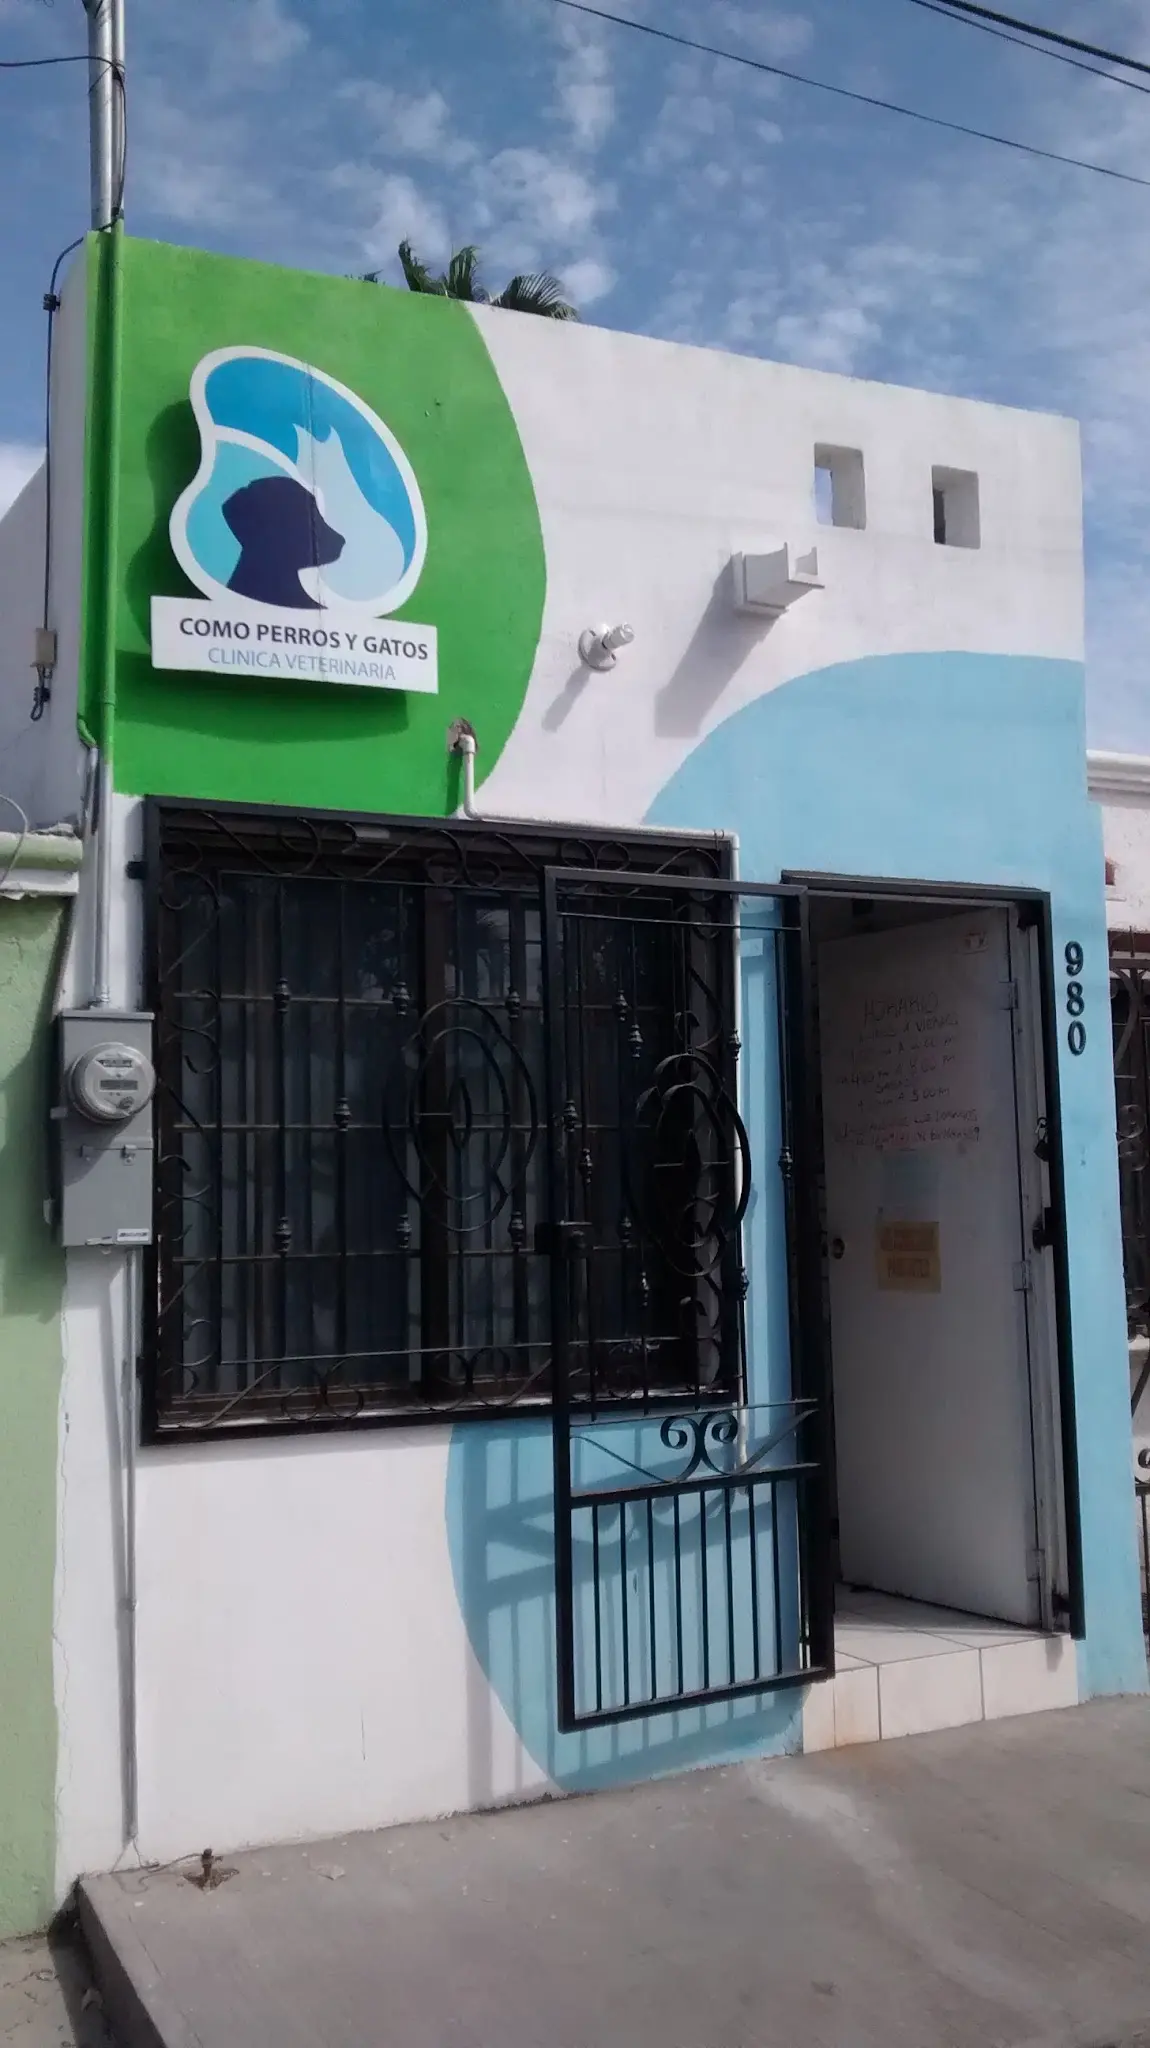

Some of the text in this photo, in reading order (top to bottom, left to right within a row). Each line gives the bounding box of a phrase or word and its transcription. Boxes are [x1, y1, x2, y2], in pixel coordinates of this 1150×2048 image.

[179, 617, 429, 660] COMO PERROS Y GATOS
[208, 647, 396, 680] CLINICA VETERINARIA
[1065, 941, 1086, 1056] 980
